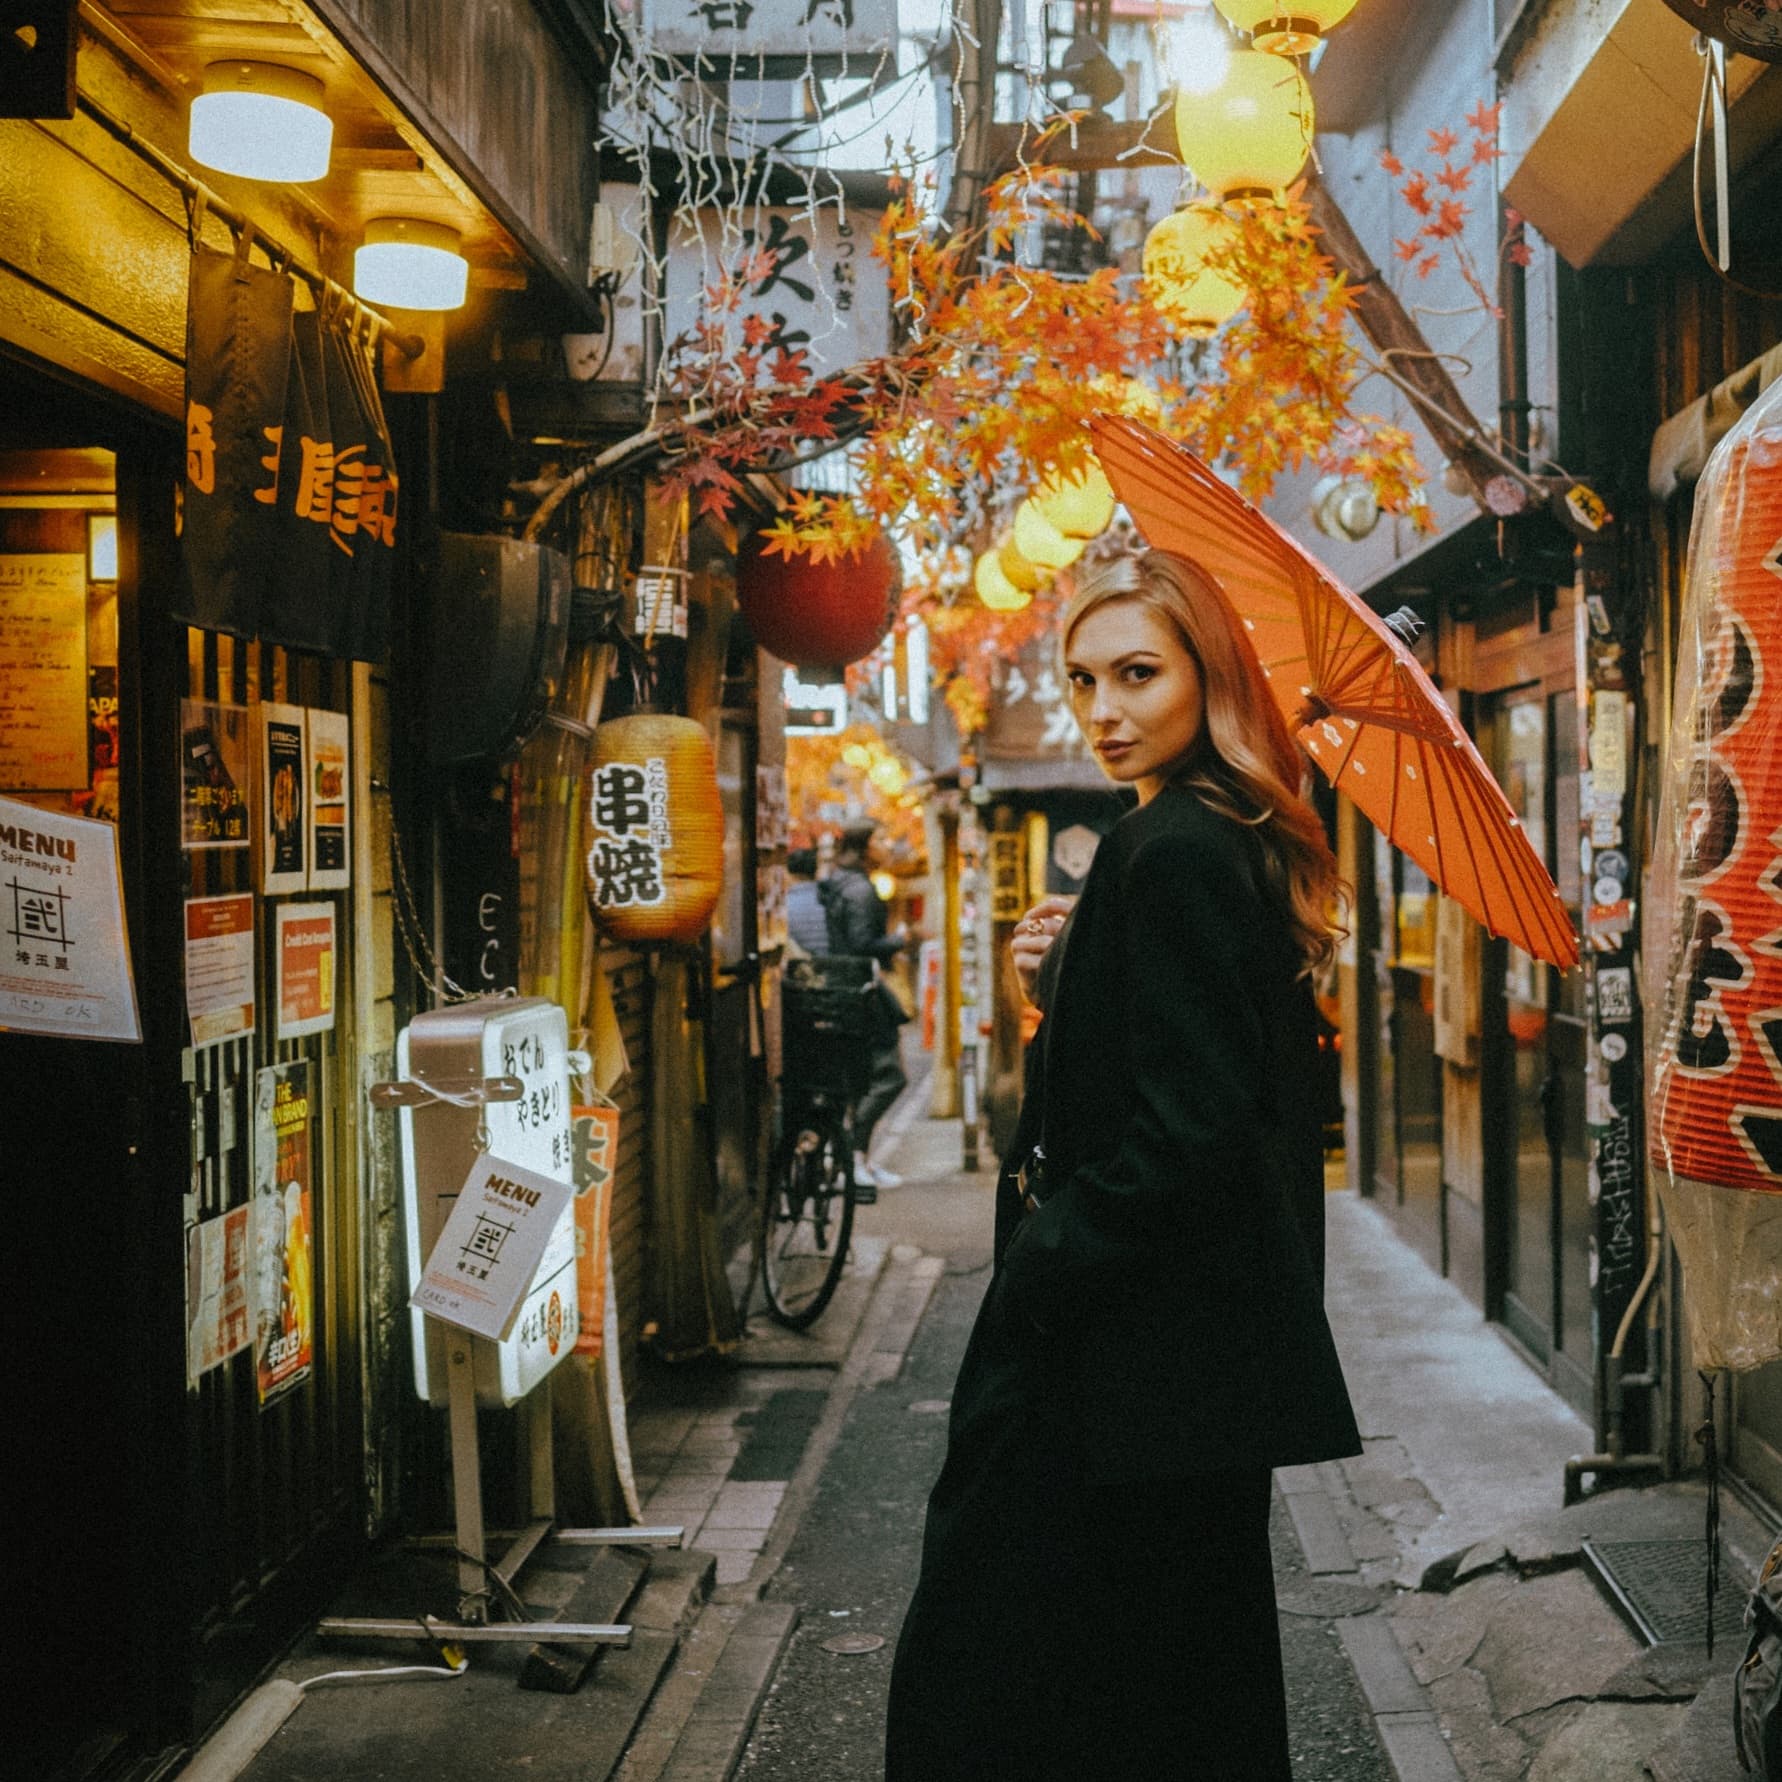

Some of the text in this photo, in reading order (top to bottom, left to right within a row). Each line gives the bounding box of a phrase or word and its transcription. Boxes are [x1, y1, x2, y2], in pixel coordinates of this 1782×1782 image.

[0, 823, 76, 863] MENU
[593, 766, 661, 906] 串焼
[1, 850, 61, 876] Saitamaya
[504, 1034, 544, 1077] おでん
[517, 1080, 560, 1132] やきとり
[484, 1173, 542, 1208] MENU
